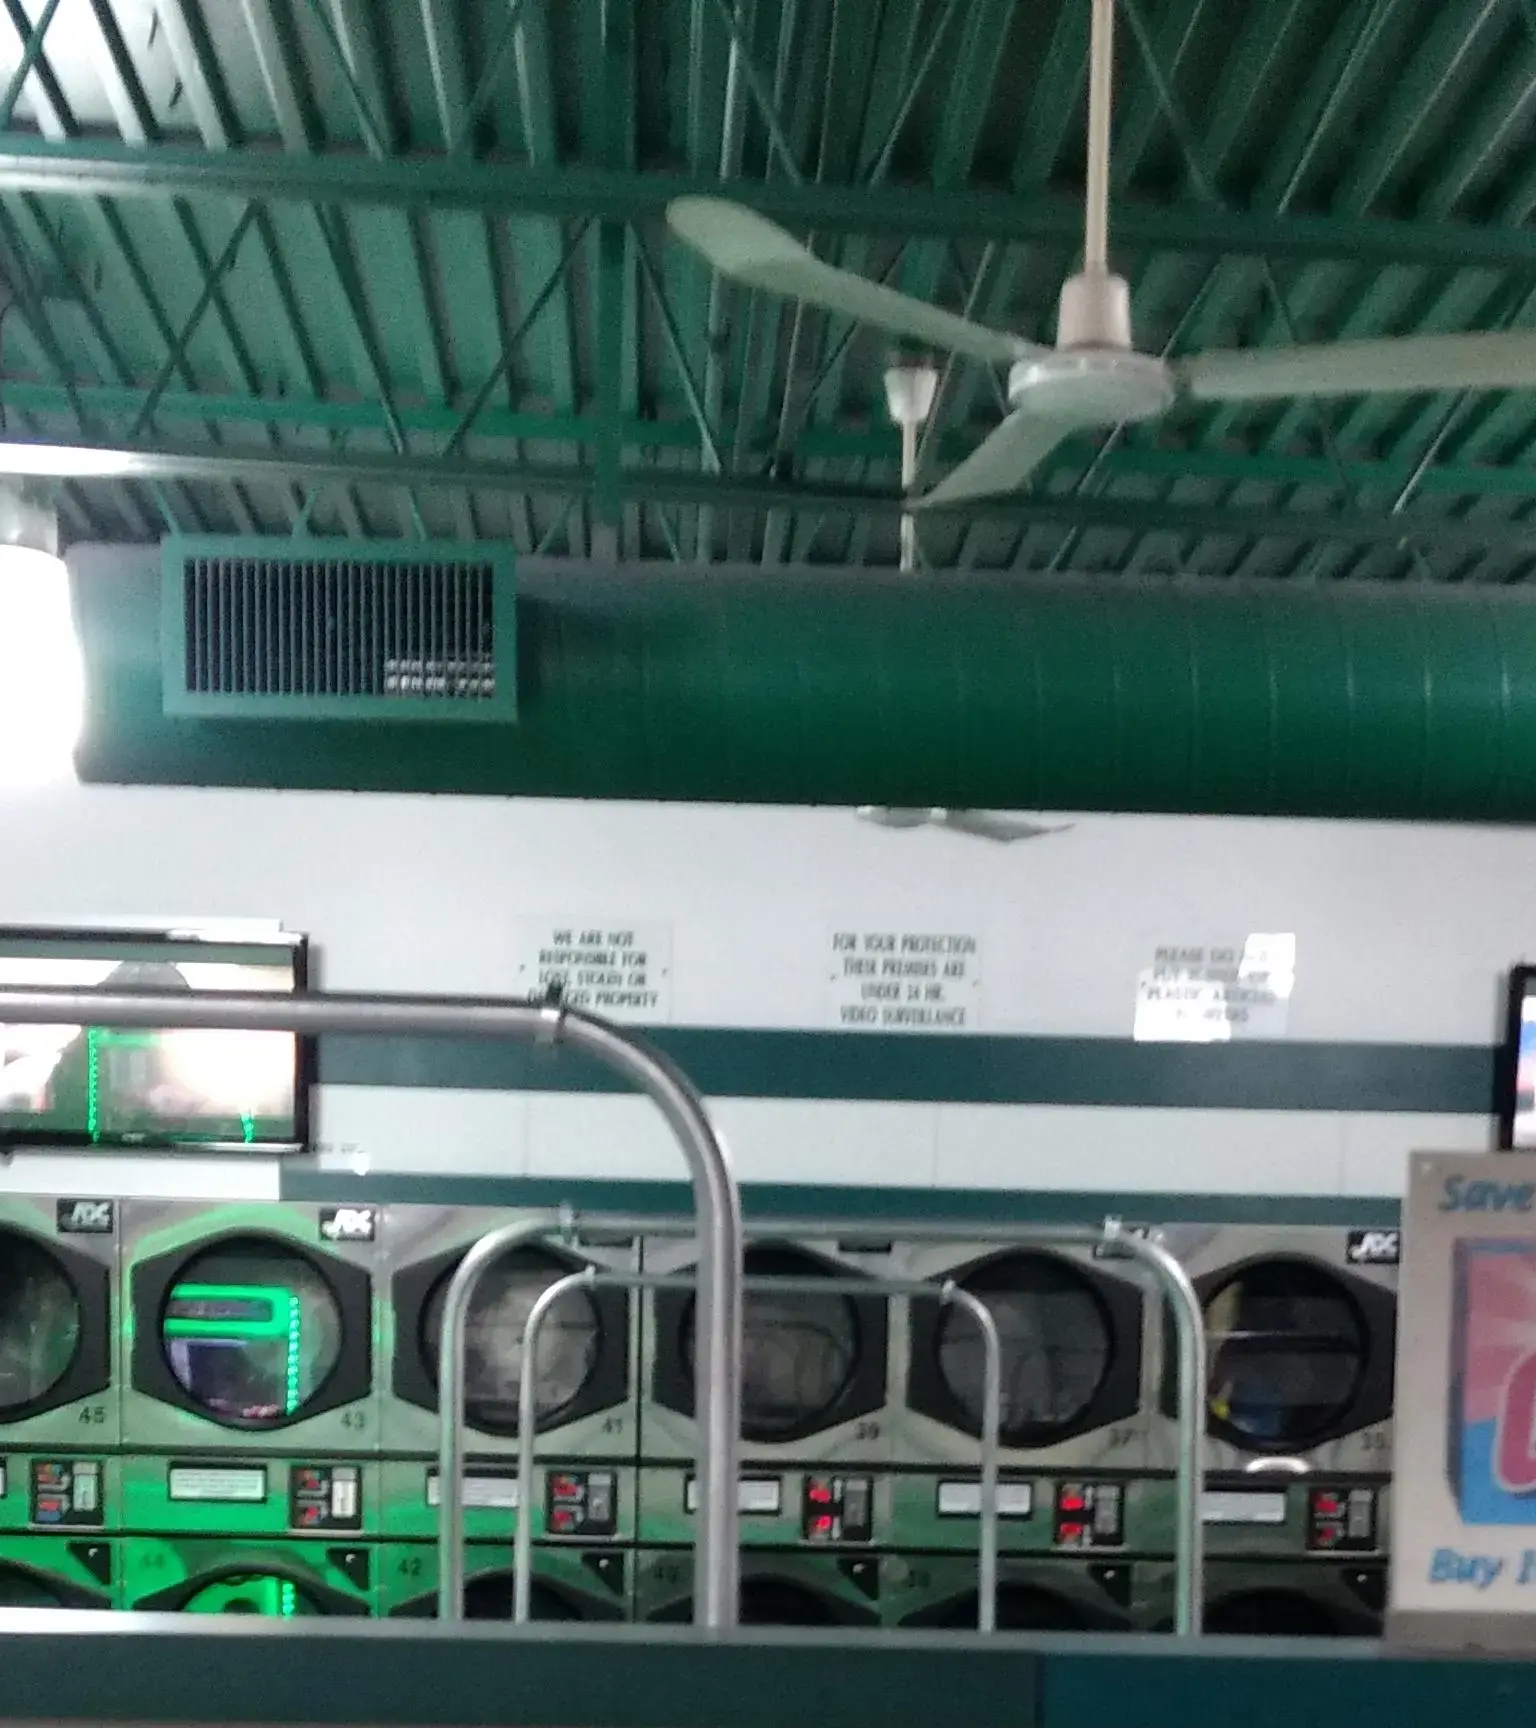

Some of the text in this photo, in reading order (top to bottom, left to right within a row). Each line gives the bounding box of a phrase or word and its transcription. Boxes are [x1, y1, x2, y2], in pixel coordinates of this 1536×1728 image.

[1438, 1174, 1536, 1213] Save
[78, 1406, 107, 1425] 45
[1427, 1547, 1504, 1590] Buy
